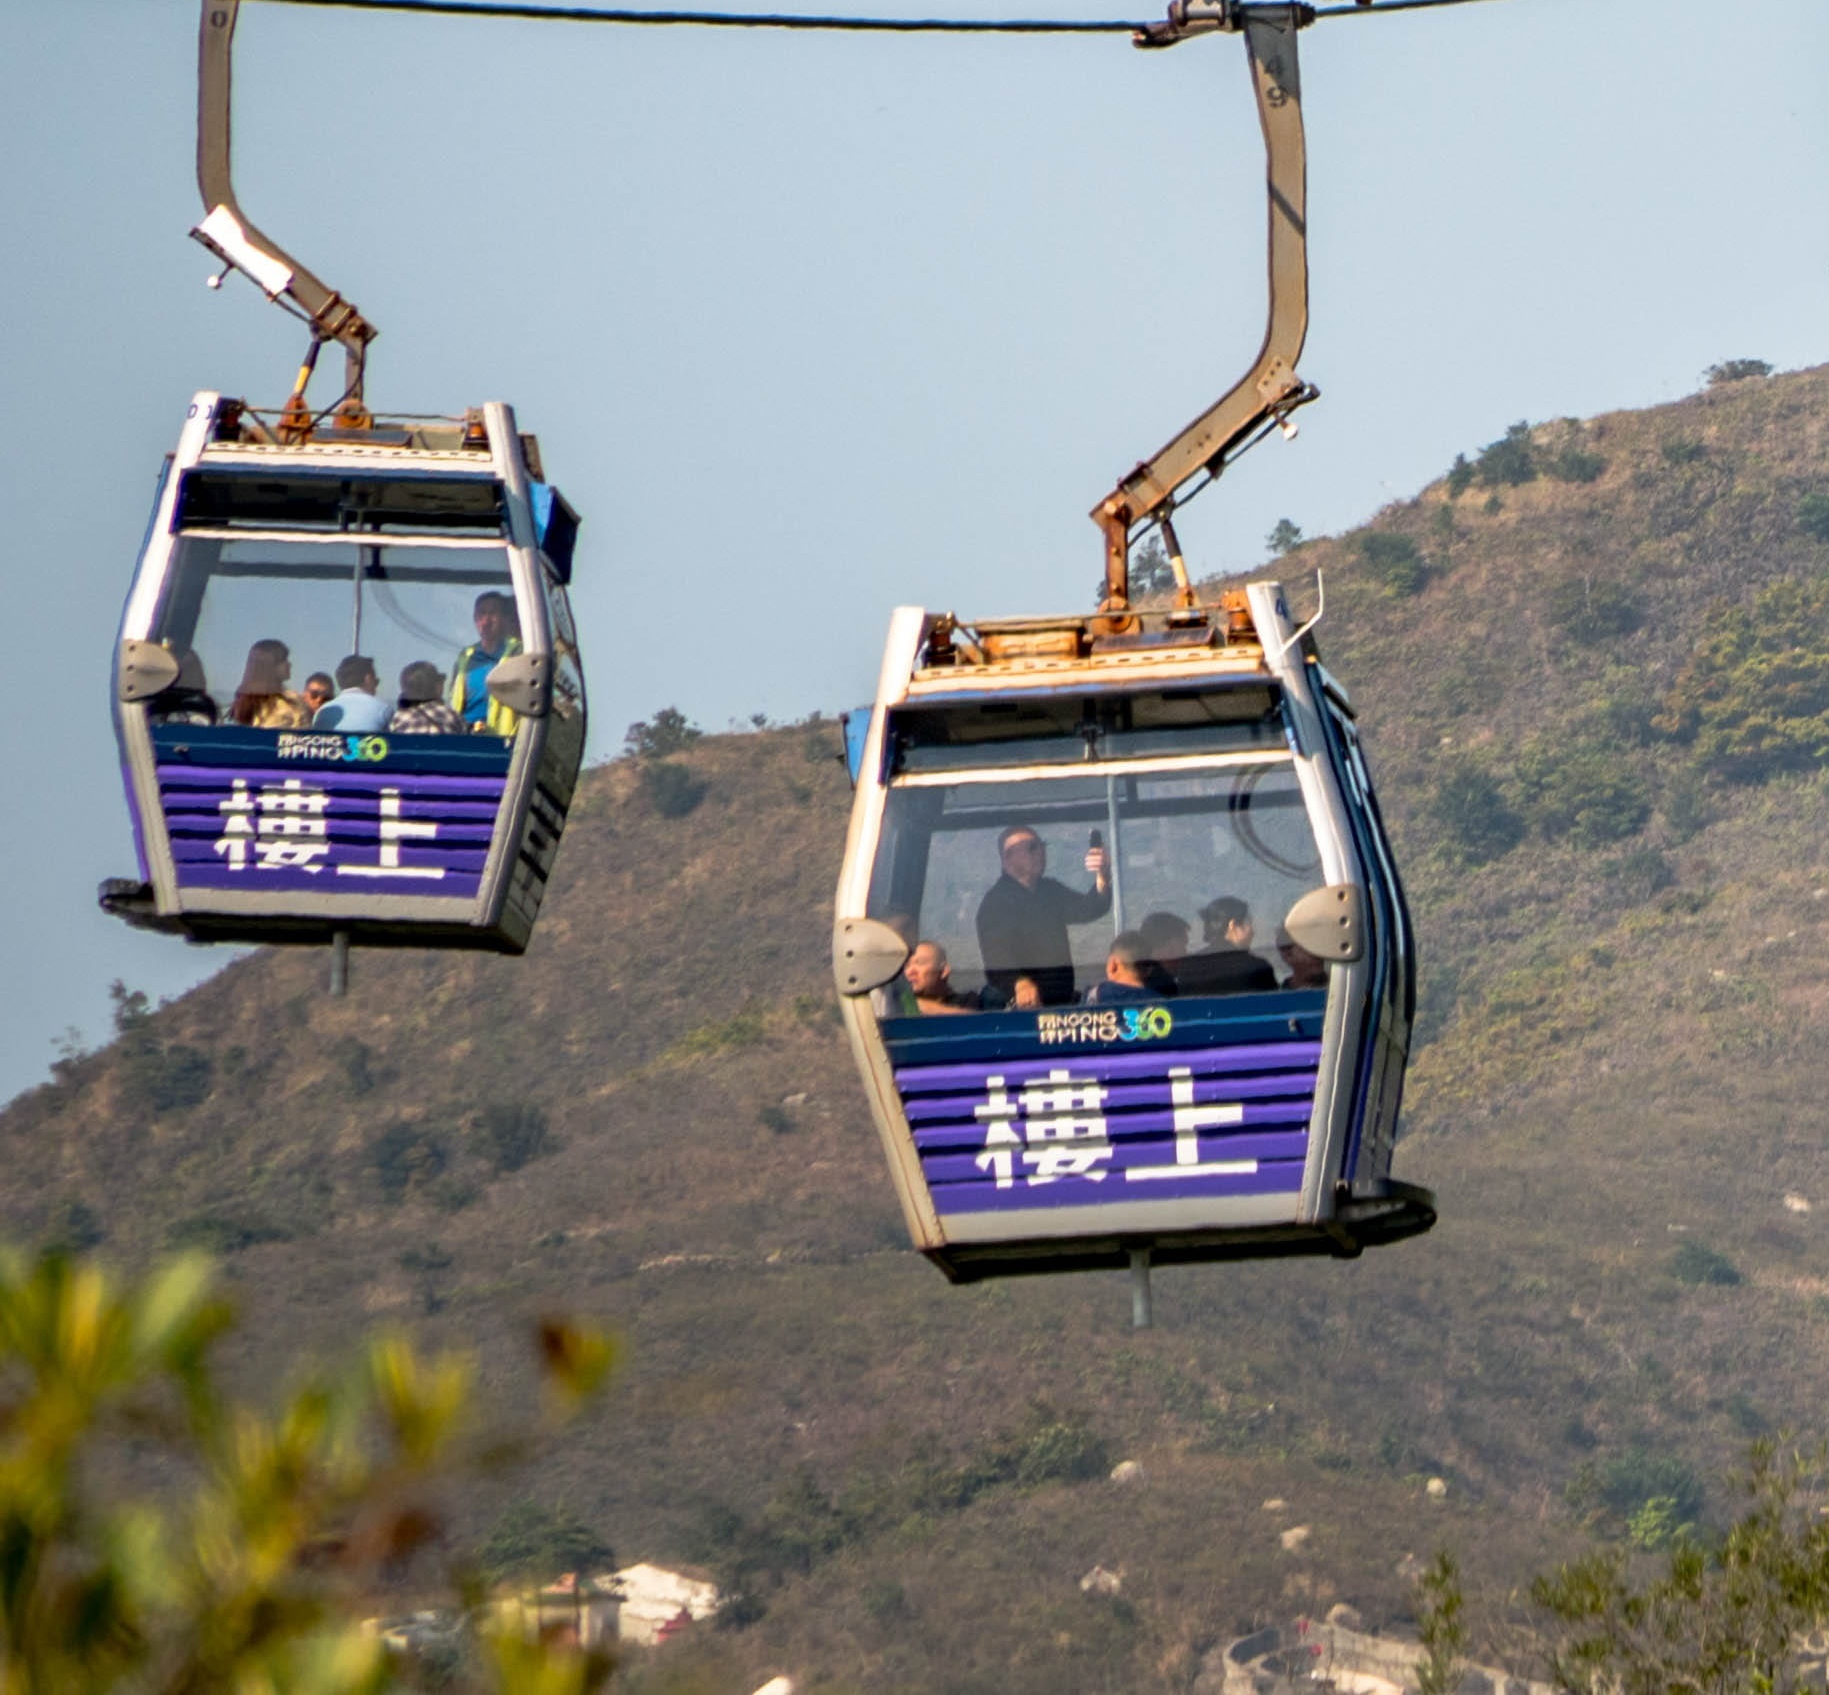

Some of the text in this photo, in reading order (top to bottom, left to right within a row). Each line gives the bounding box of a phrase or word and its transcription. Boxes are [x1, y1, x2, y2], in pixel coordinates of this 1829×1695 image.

[341, 735, 388, 762] 360
[214, 779, 445, 878] 樓上
[1118, 1006, 1172, 1041] 360
[974, 1067, 1258, 1189] 樓上
